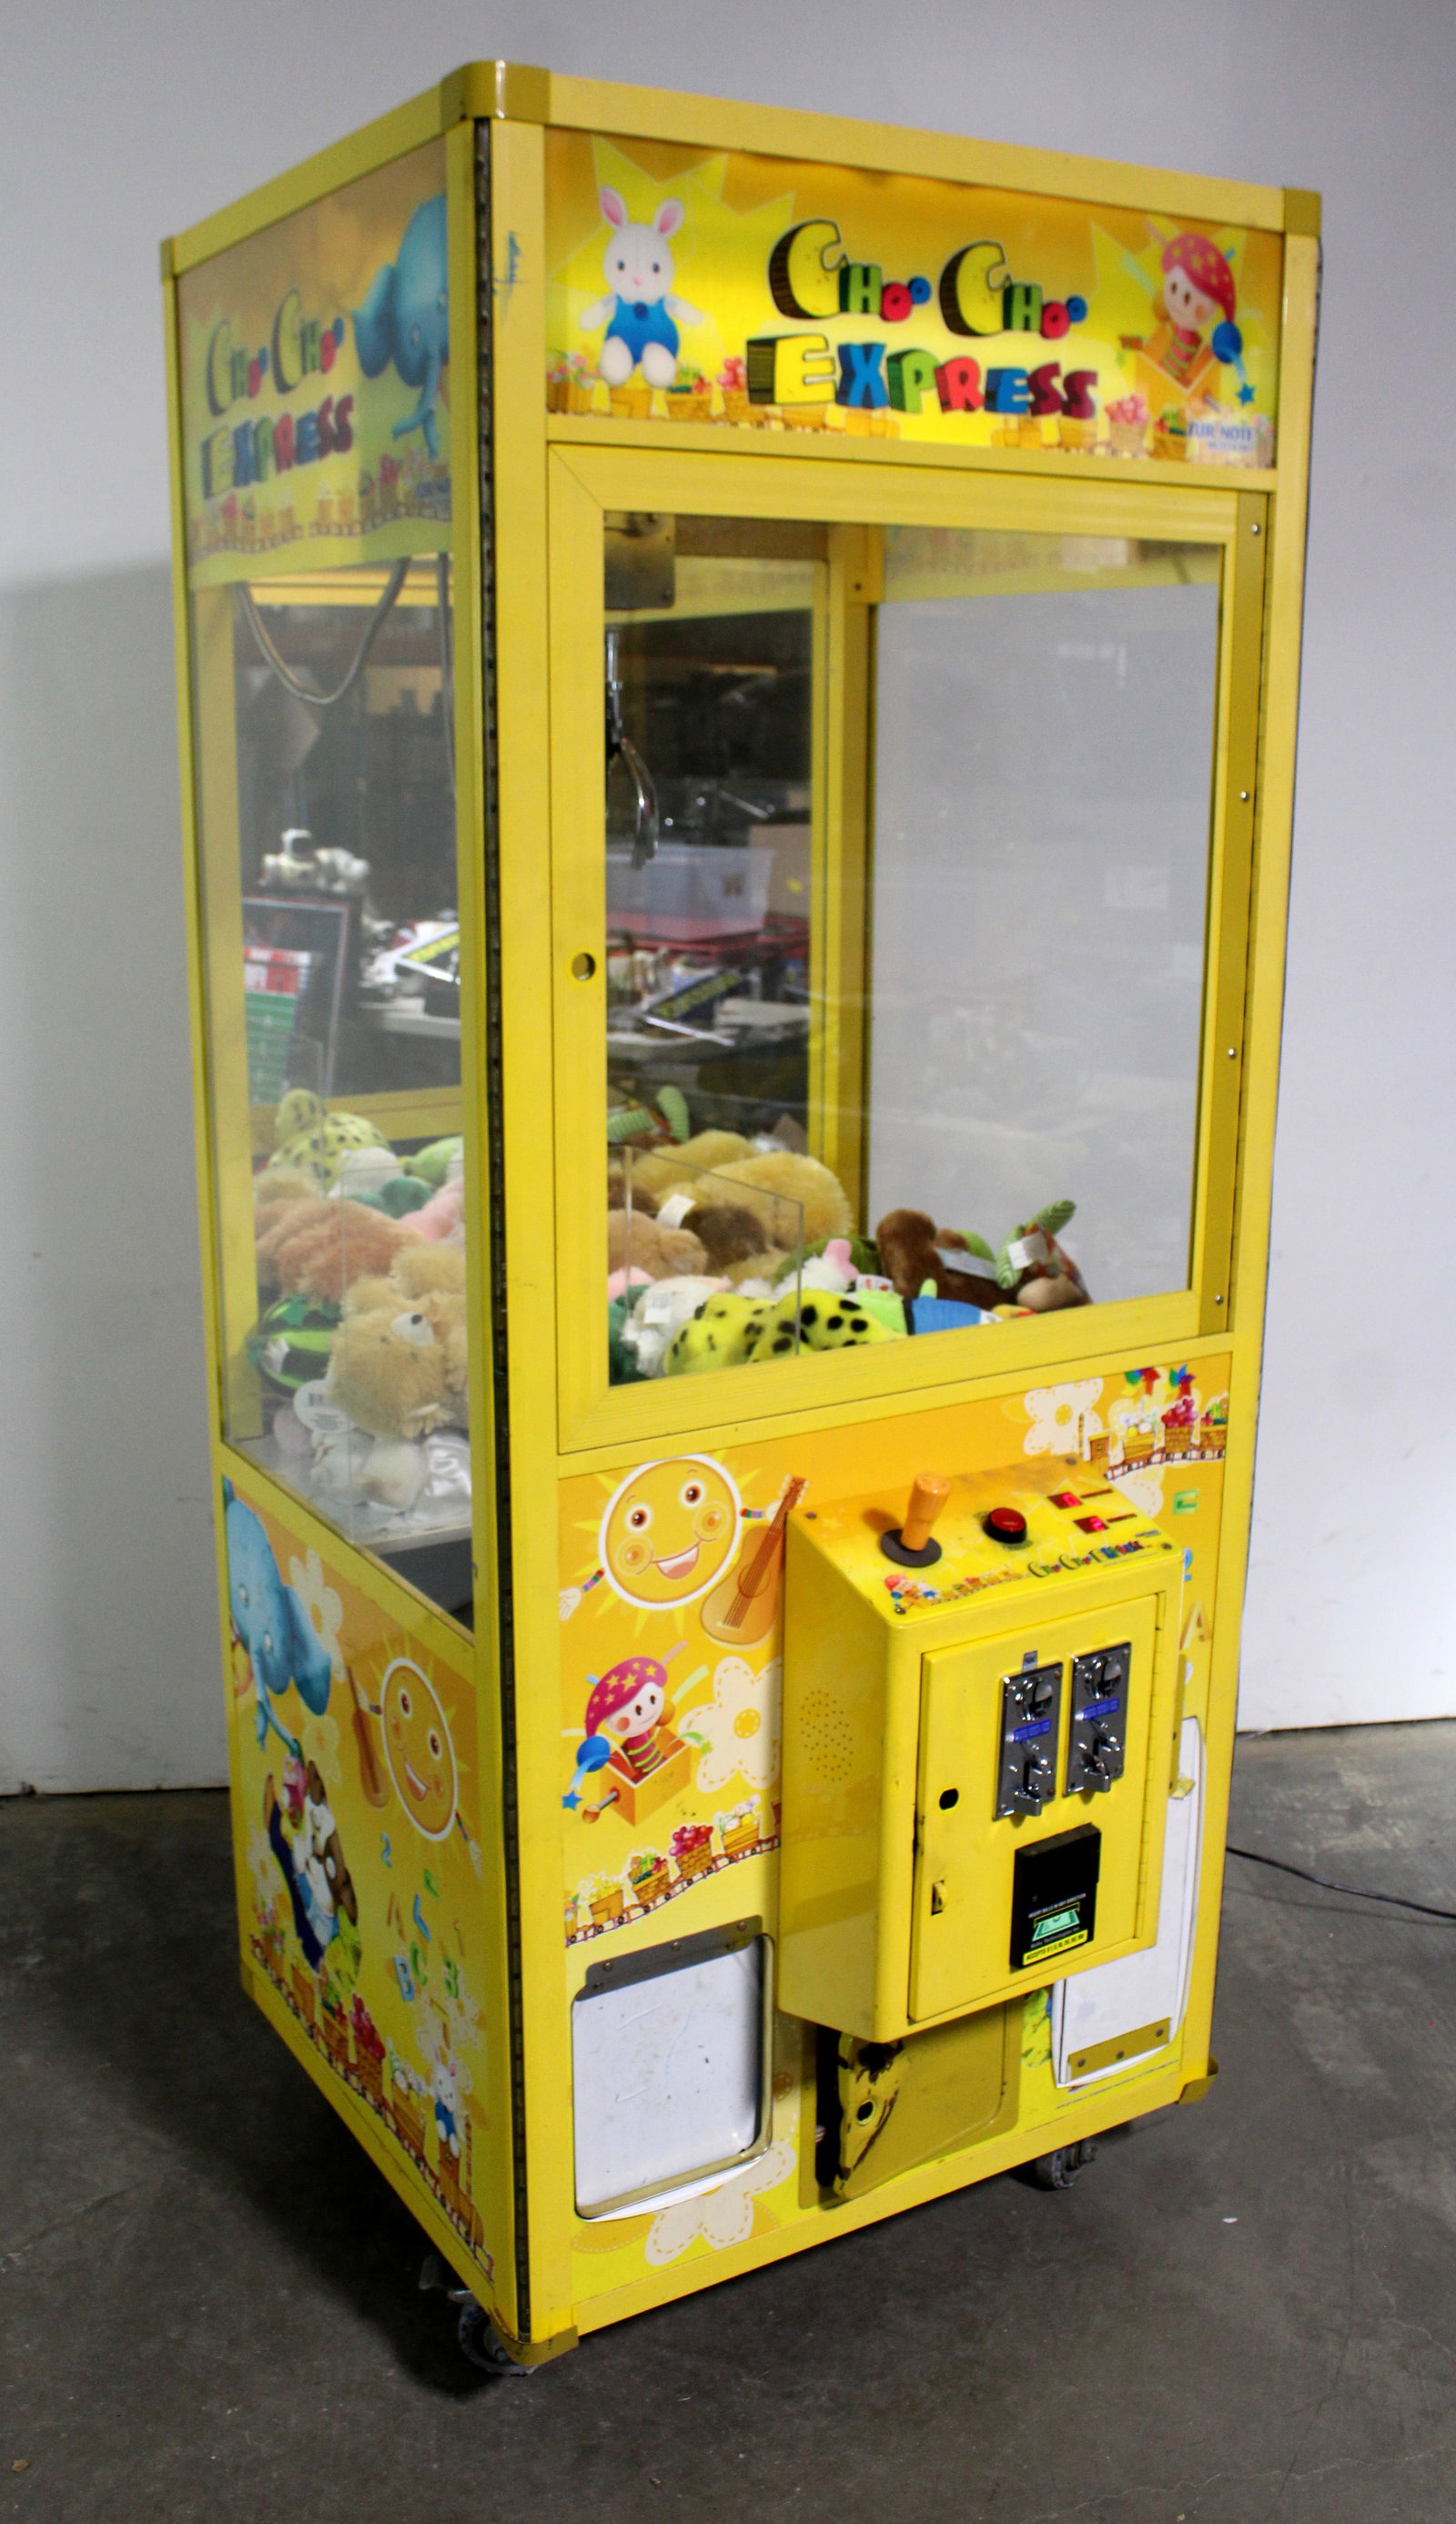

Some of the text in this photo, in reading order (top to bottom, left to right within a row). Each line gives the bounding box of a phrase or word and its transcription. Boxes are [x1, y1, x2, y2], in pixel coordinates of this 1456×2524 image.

[746, 333, 1097, 419] EXPRESS
[201, 394, 354, 500] EXPRESS
[393, 1955, 416, 2002] B
